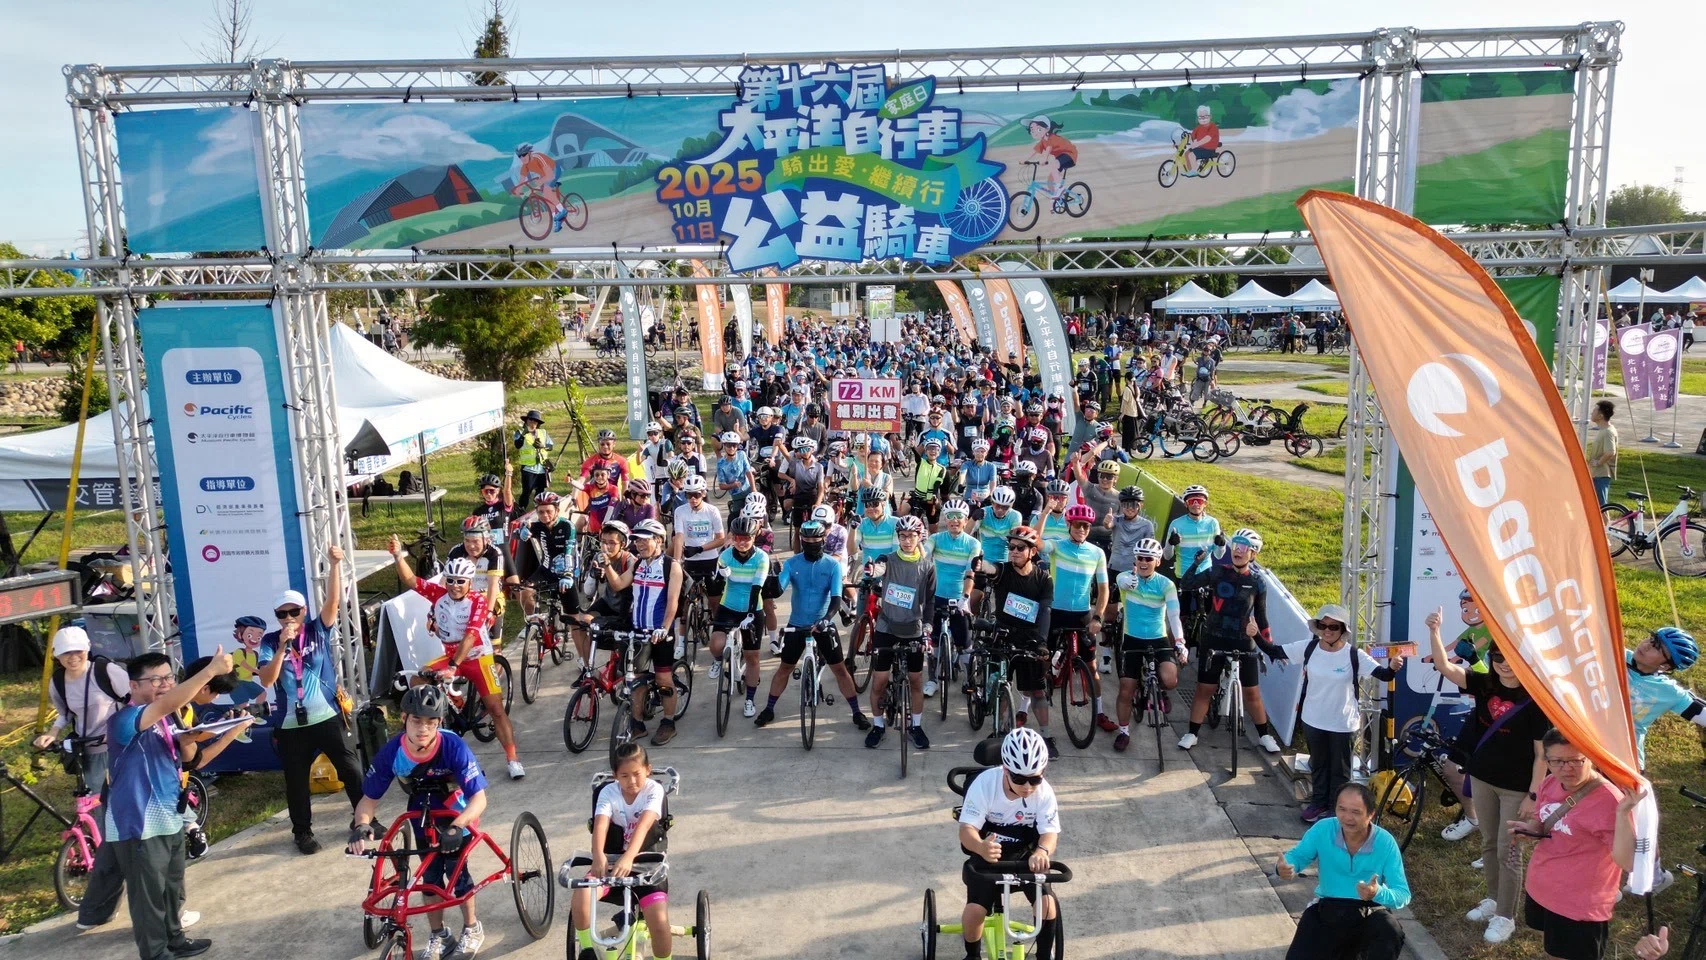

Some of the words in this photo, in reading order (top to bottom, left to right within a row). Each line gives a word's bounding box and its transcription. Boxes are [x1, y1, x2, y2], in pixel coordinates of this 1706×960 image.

[742, 64, 885, 112] 第十六屆
[884, 85, 928, 116] 家庭日
[685, 103, 960, 166] 太平洋自行車
[658, 159, 763, 200] 2025
[672, 199, 713, 219] 10月
[675, 222, 716, 241] 11日
[720, 189, 953, 272] 公益騎車
[192, 372, 234, 383] 主辦單位
[840, 384, 861, 399] 72
[869, 386, 895, 398] KM
[200, 404, 253, 415] Pacific
[206, 479, 247, 490] 指導單位
[895, 591, 912, 601] 1308
[1014, 601, 1030, 613] 1090
